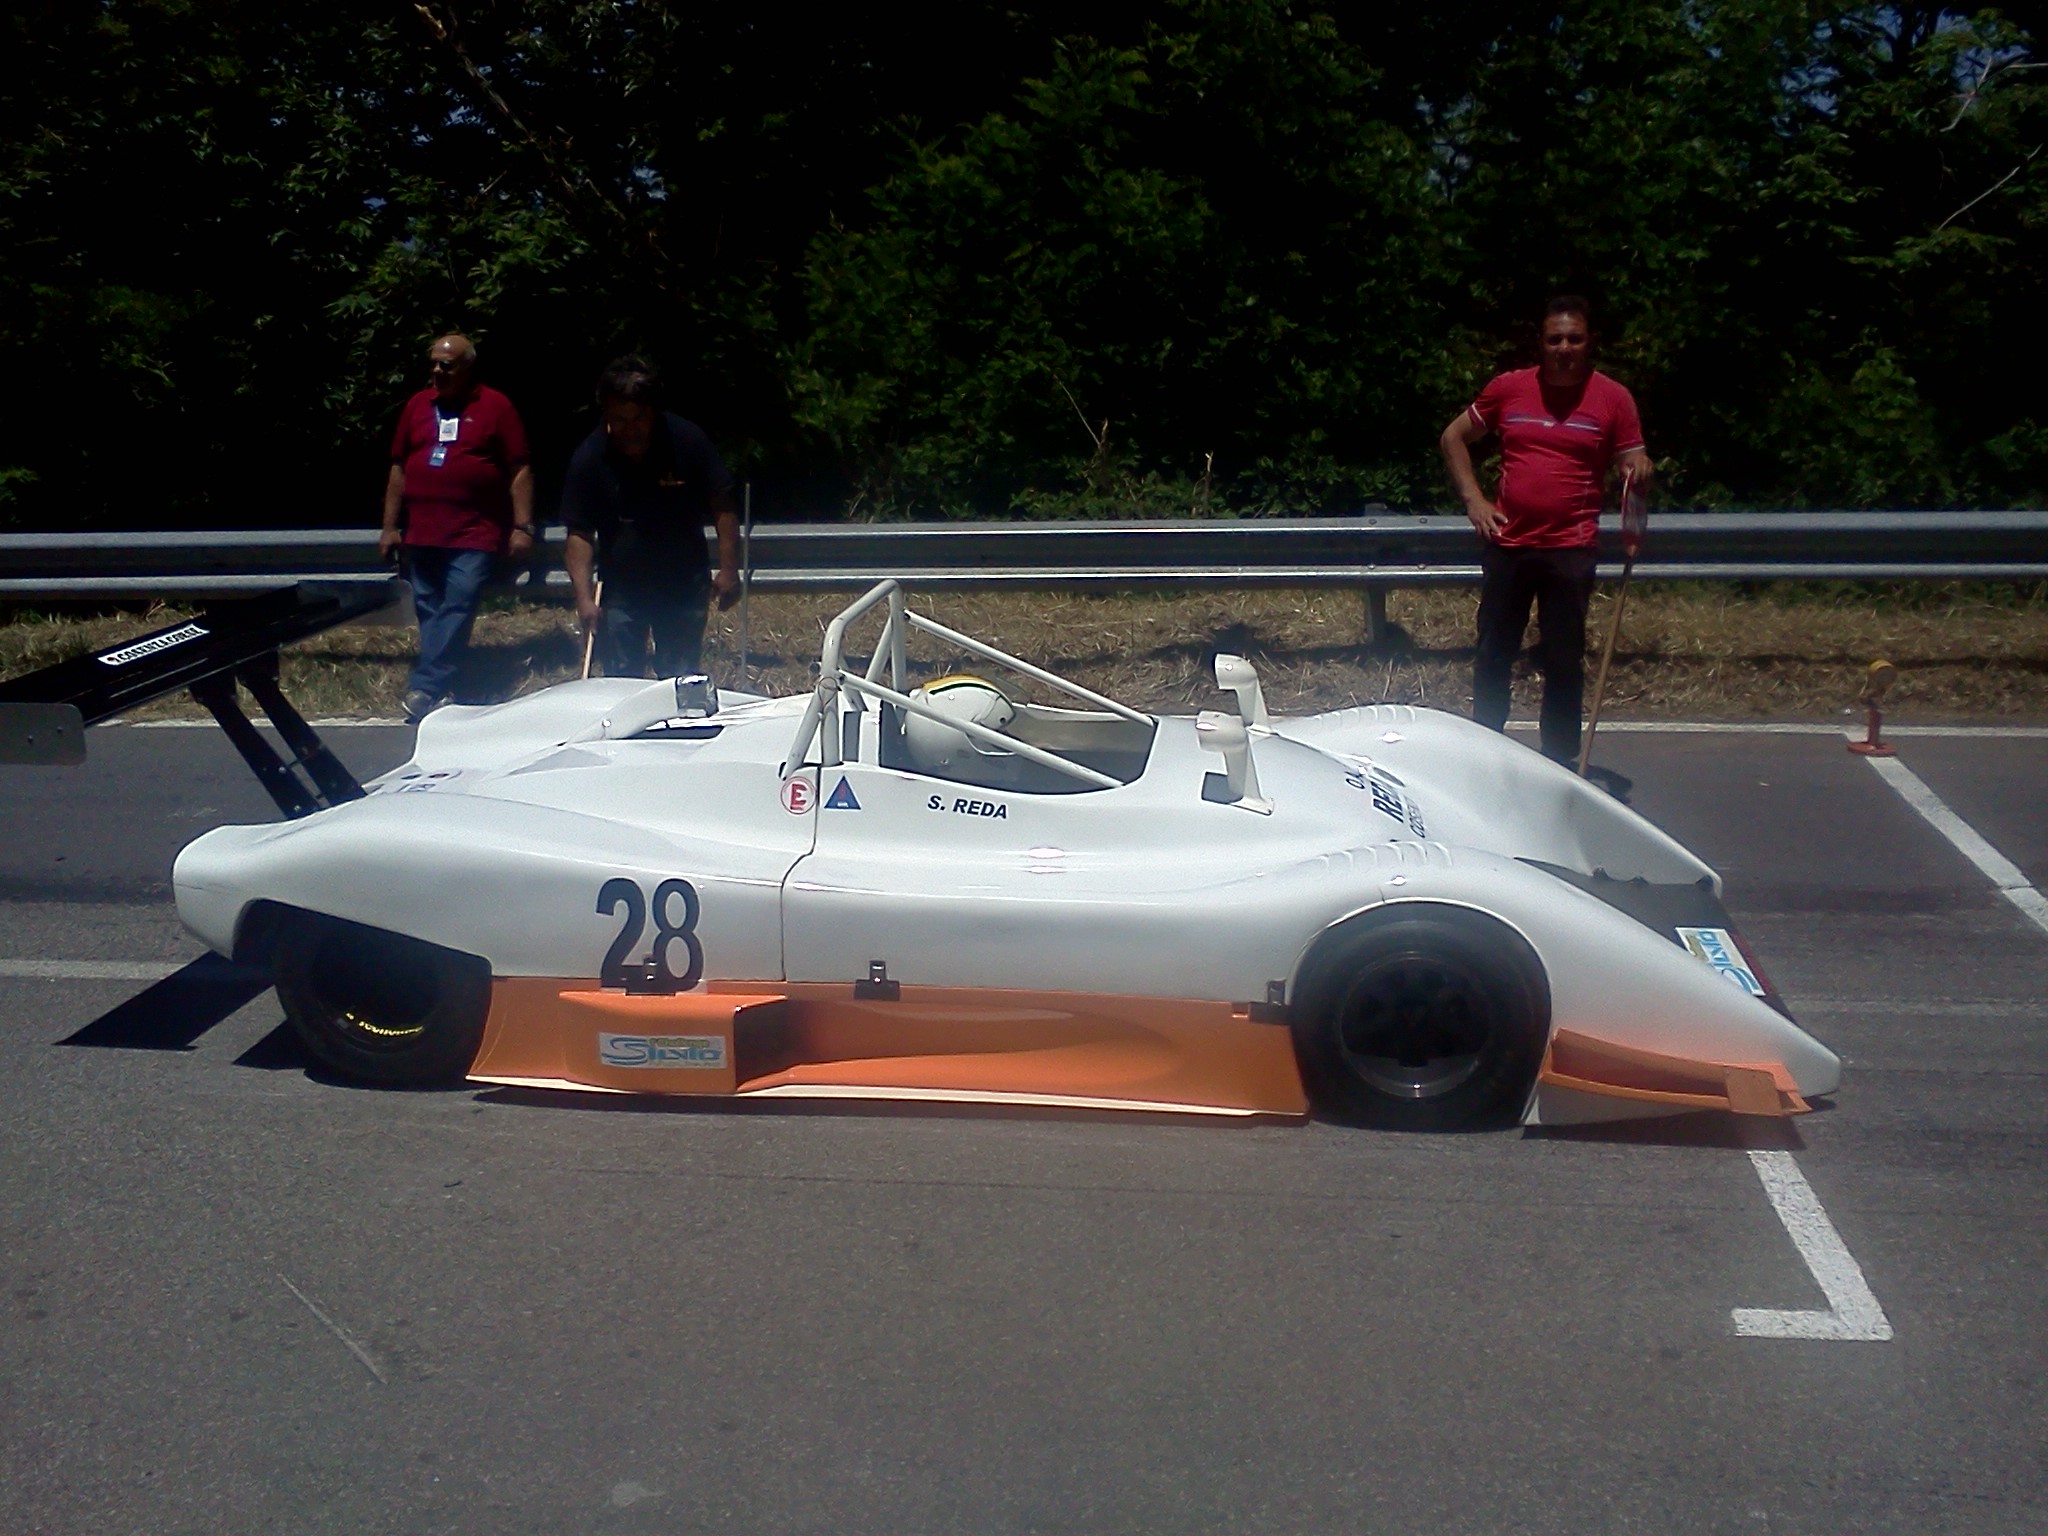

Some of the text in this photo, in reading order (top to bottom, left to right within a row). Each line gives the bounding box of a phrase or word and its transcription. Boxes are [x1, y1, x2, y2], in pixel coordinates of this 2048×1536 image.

[790, 783, 807, 810] E
[928, 794, 1008, 820] S. REDA
[595, 877, 704, 992] 28
